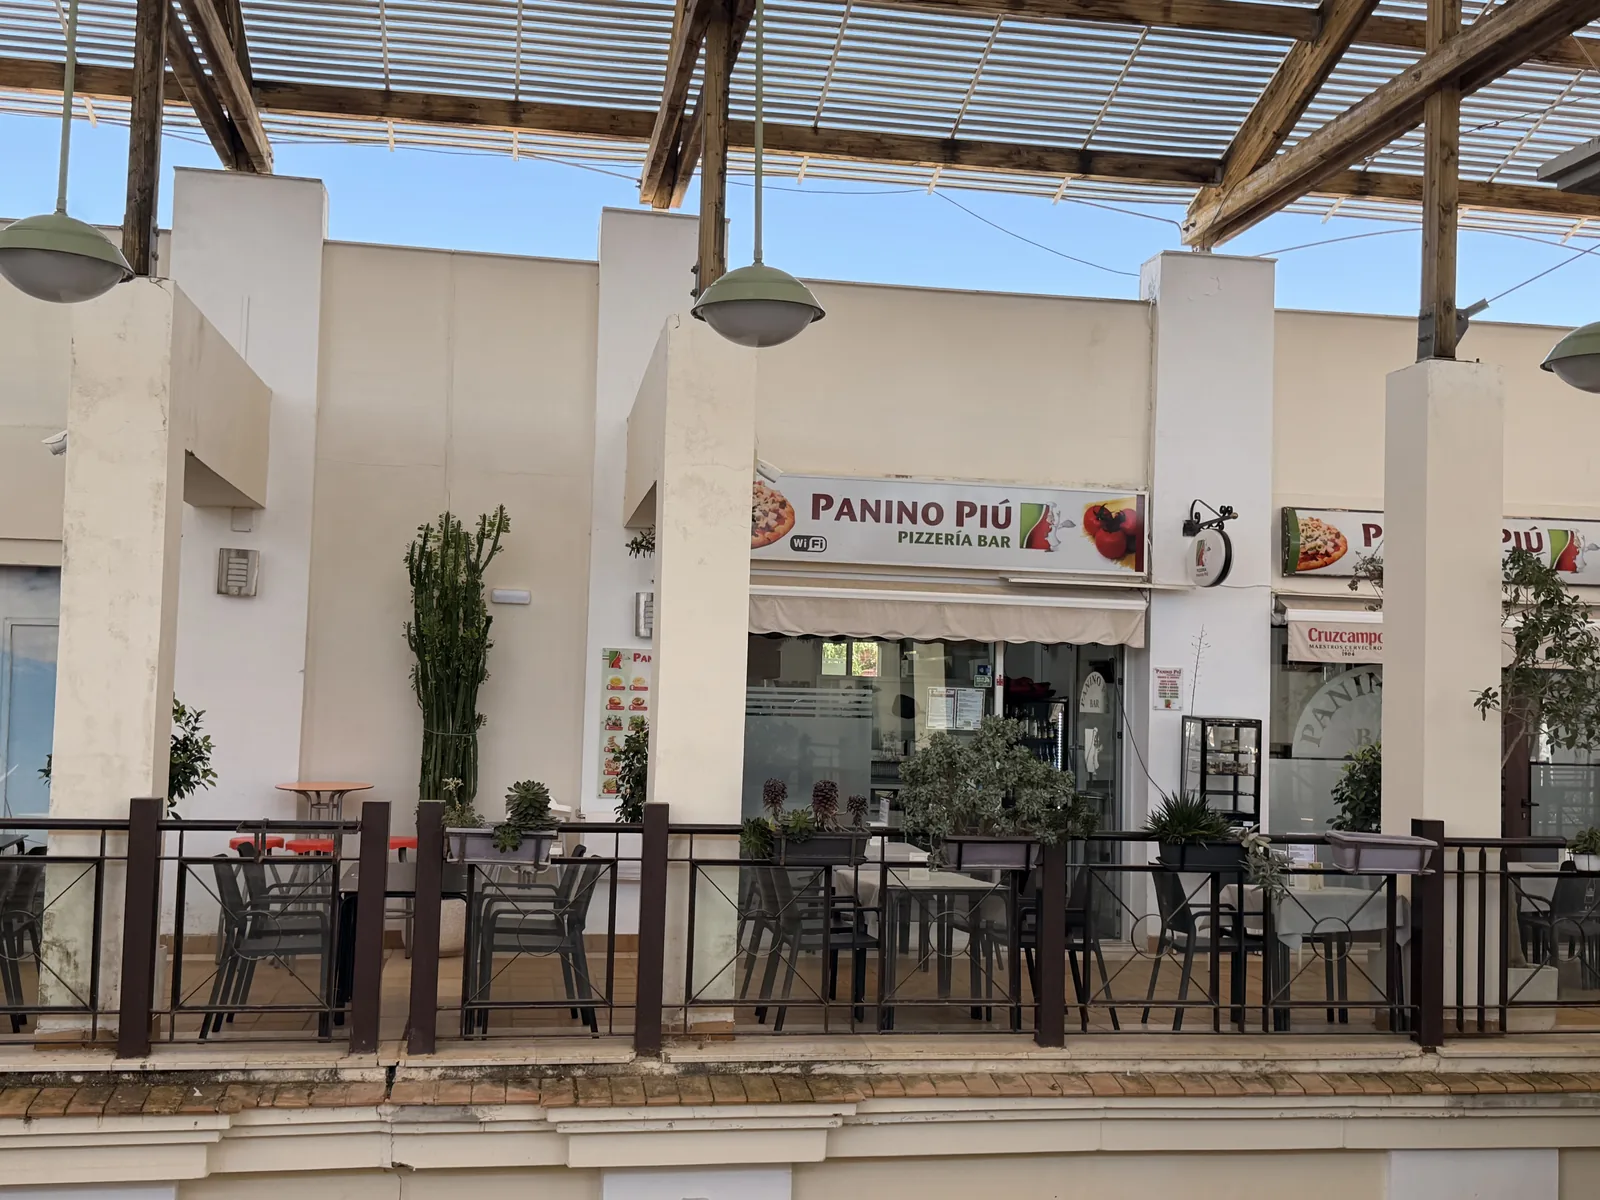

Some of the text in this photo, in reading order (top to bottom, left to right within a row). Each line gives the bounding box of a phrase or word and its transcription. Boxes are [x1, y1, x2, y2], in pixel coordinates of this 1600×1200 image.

[811, 493, 1012, 529] PANINO PIÚ
[898, 530, 1011, 548] PIZZERÍA BAR
[1089, 699, 1100, 708] BAR
